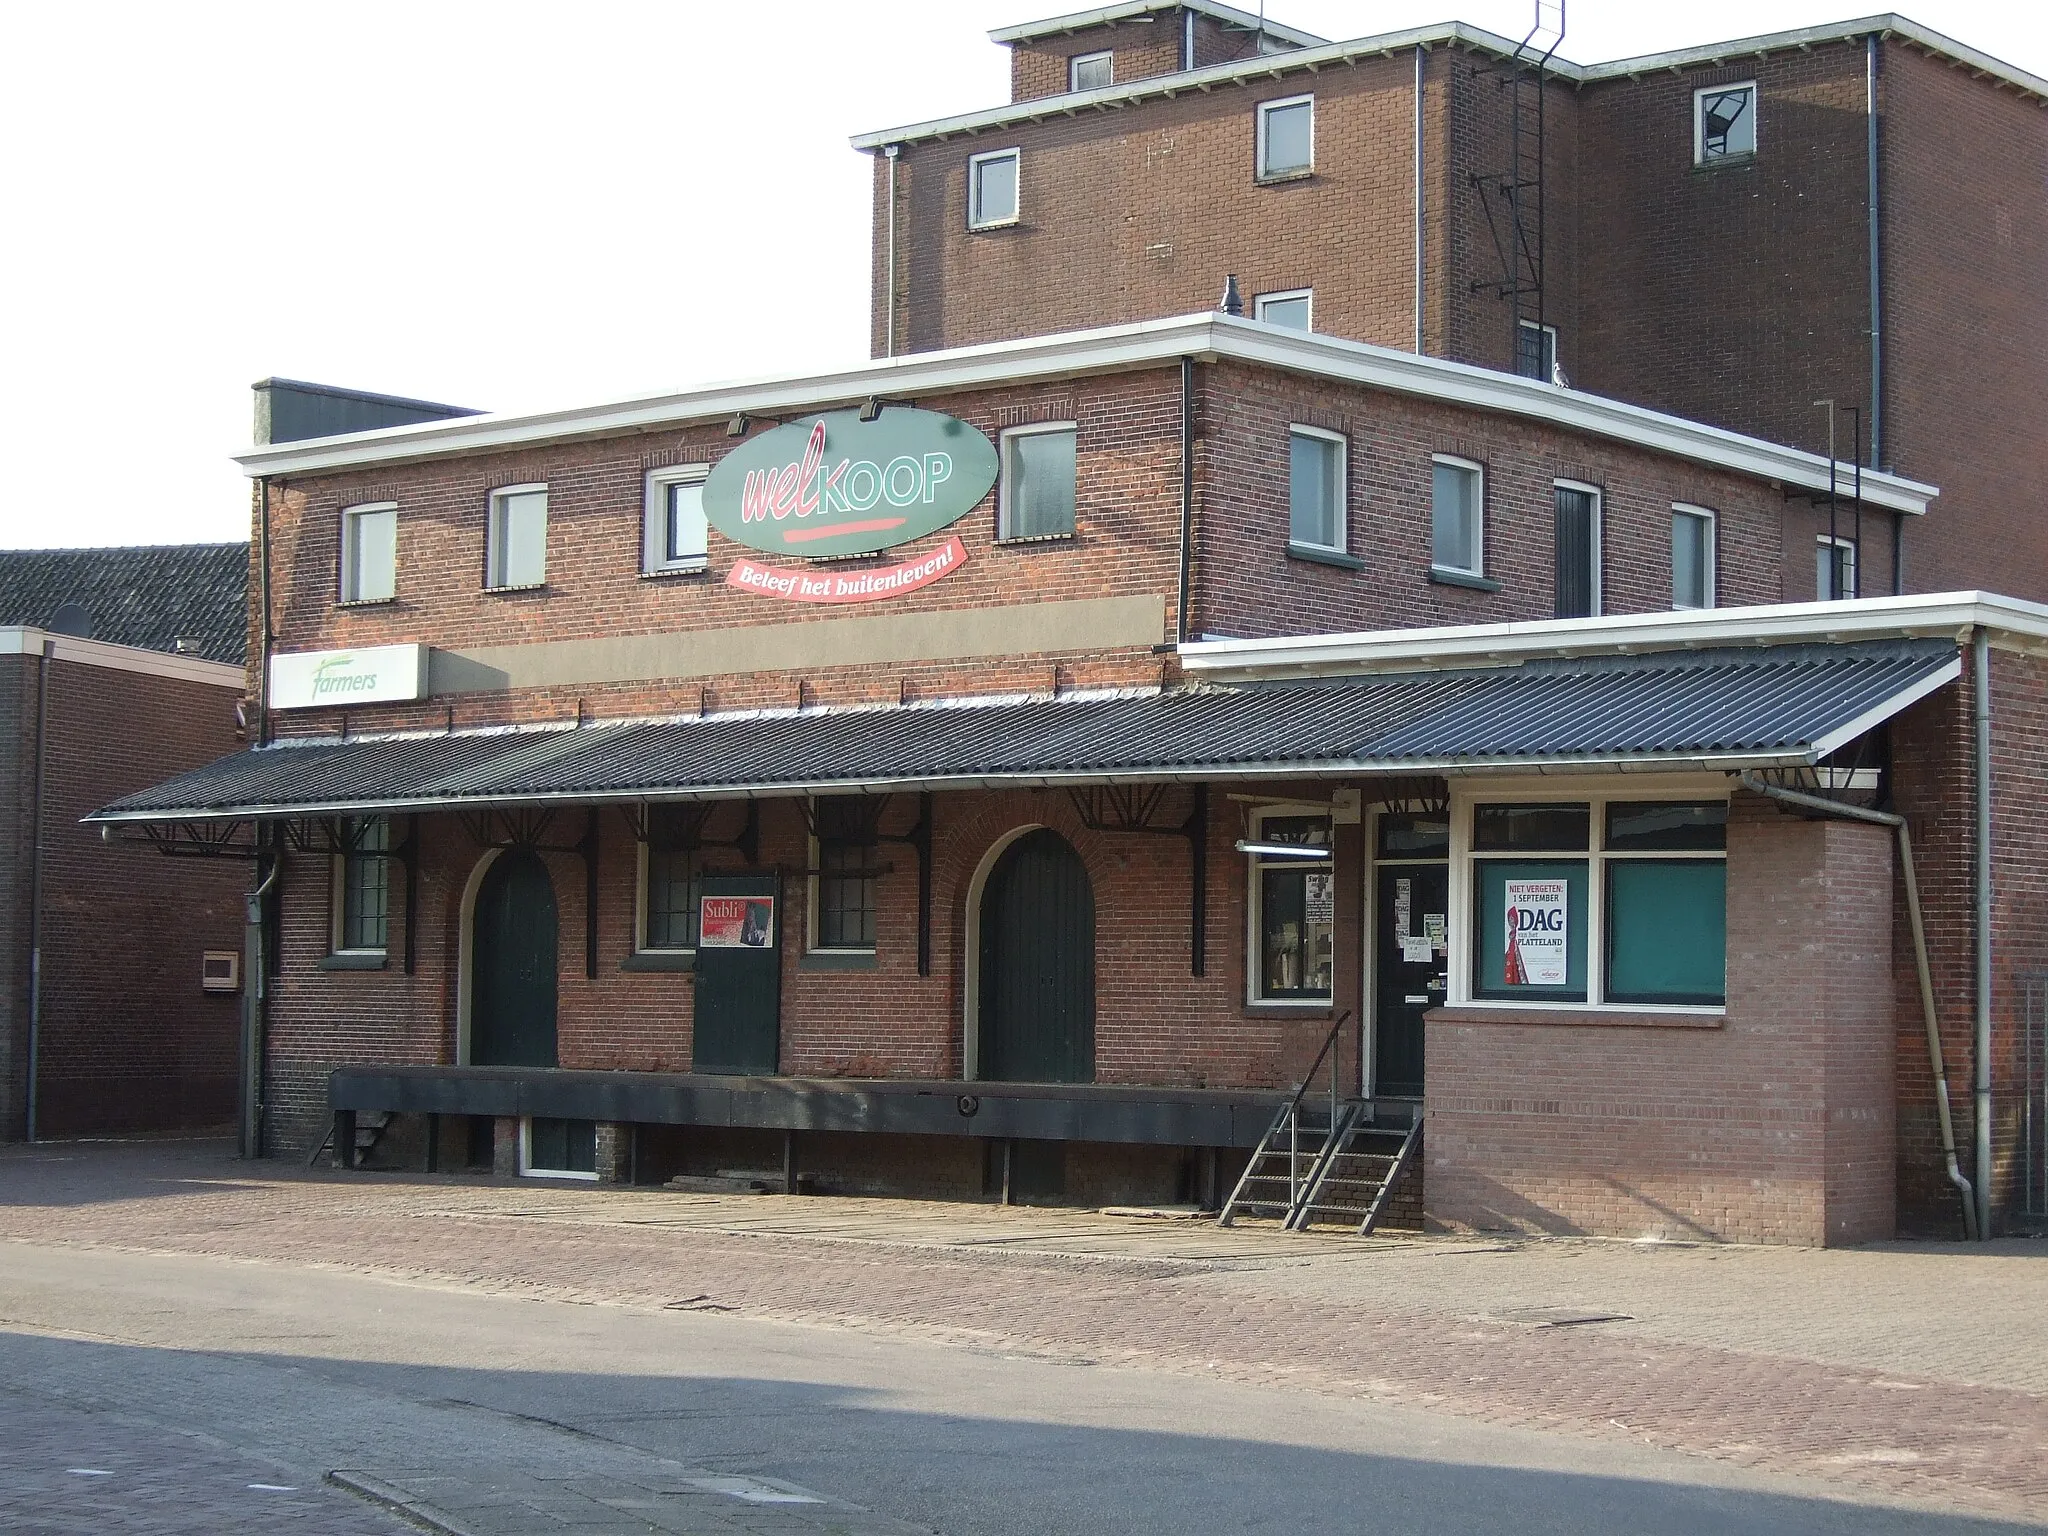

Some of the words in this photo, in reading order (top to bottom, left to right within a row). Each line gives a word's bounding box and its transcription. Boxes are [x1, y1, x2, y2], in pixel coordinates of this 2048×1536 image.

[739, 565, 799, 597] Beleef
[802, 577, 831, 596] het
[835, 544, 954, 597] buitenleven!
[1510, 885, 1526, 893] NIET
[1526, 885, 1564, 893] VERGETEN:
[1518, 894, 1559, 902] SEPTEMBER
[1518, 909, 1563, 931] DAG
[1517, 938, 1563, 946] PLATTELAND
